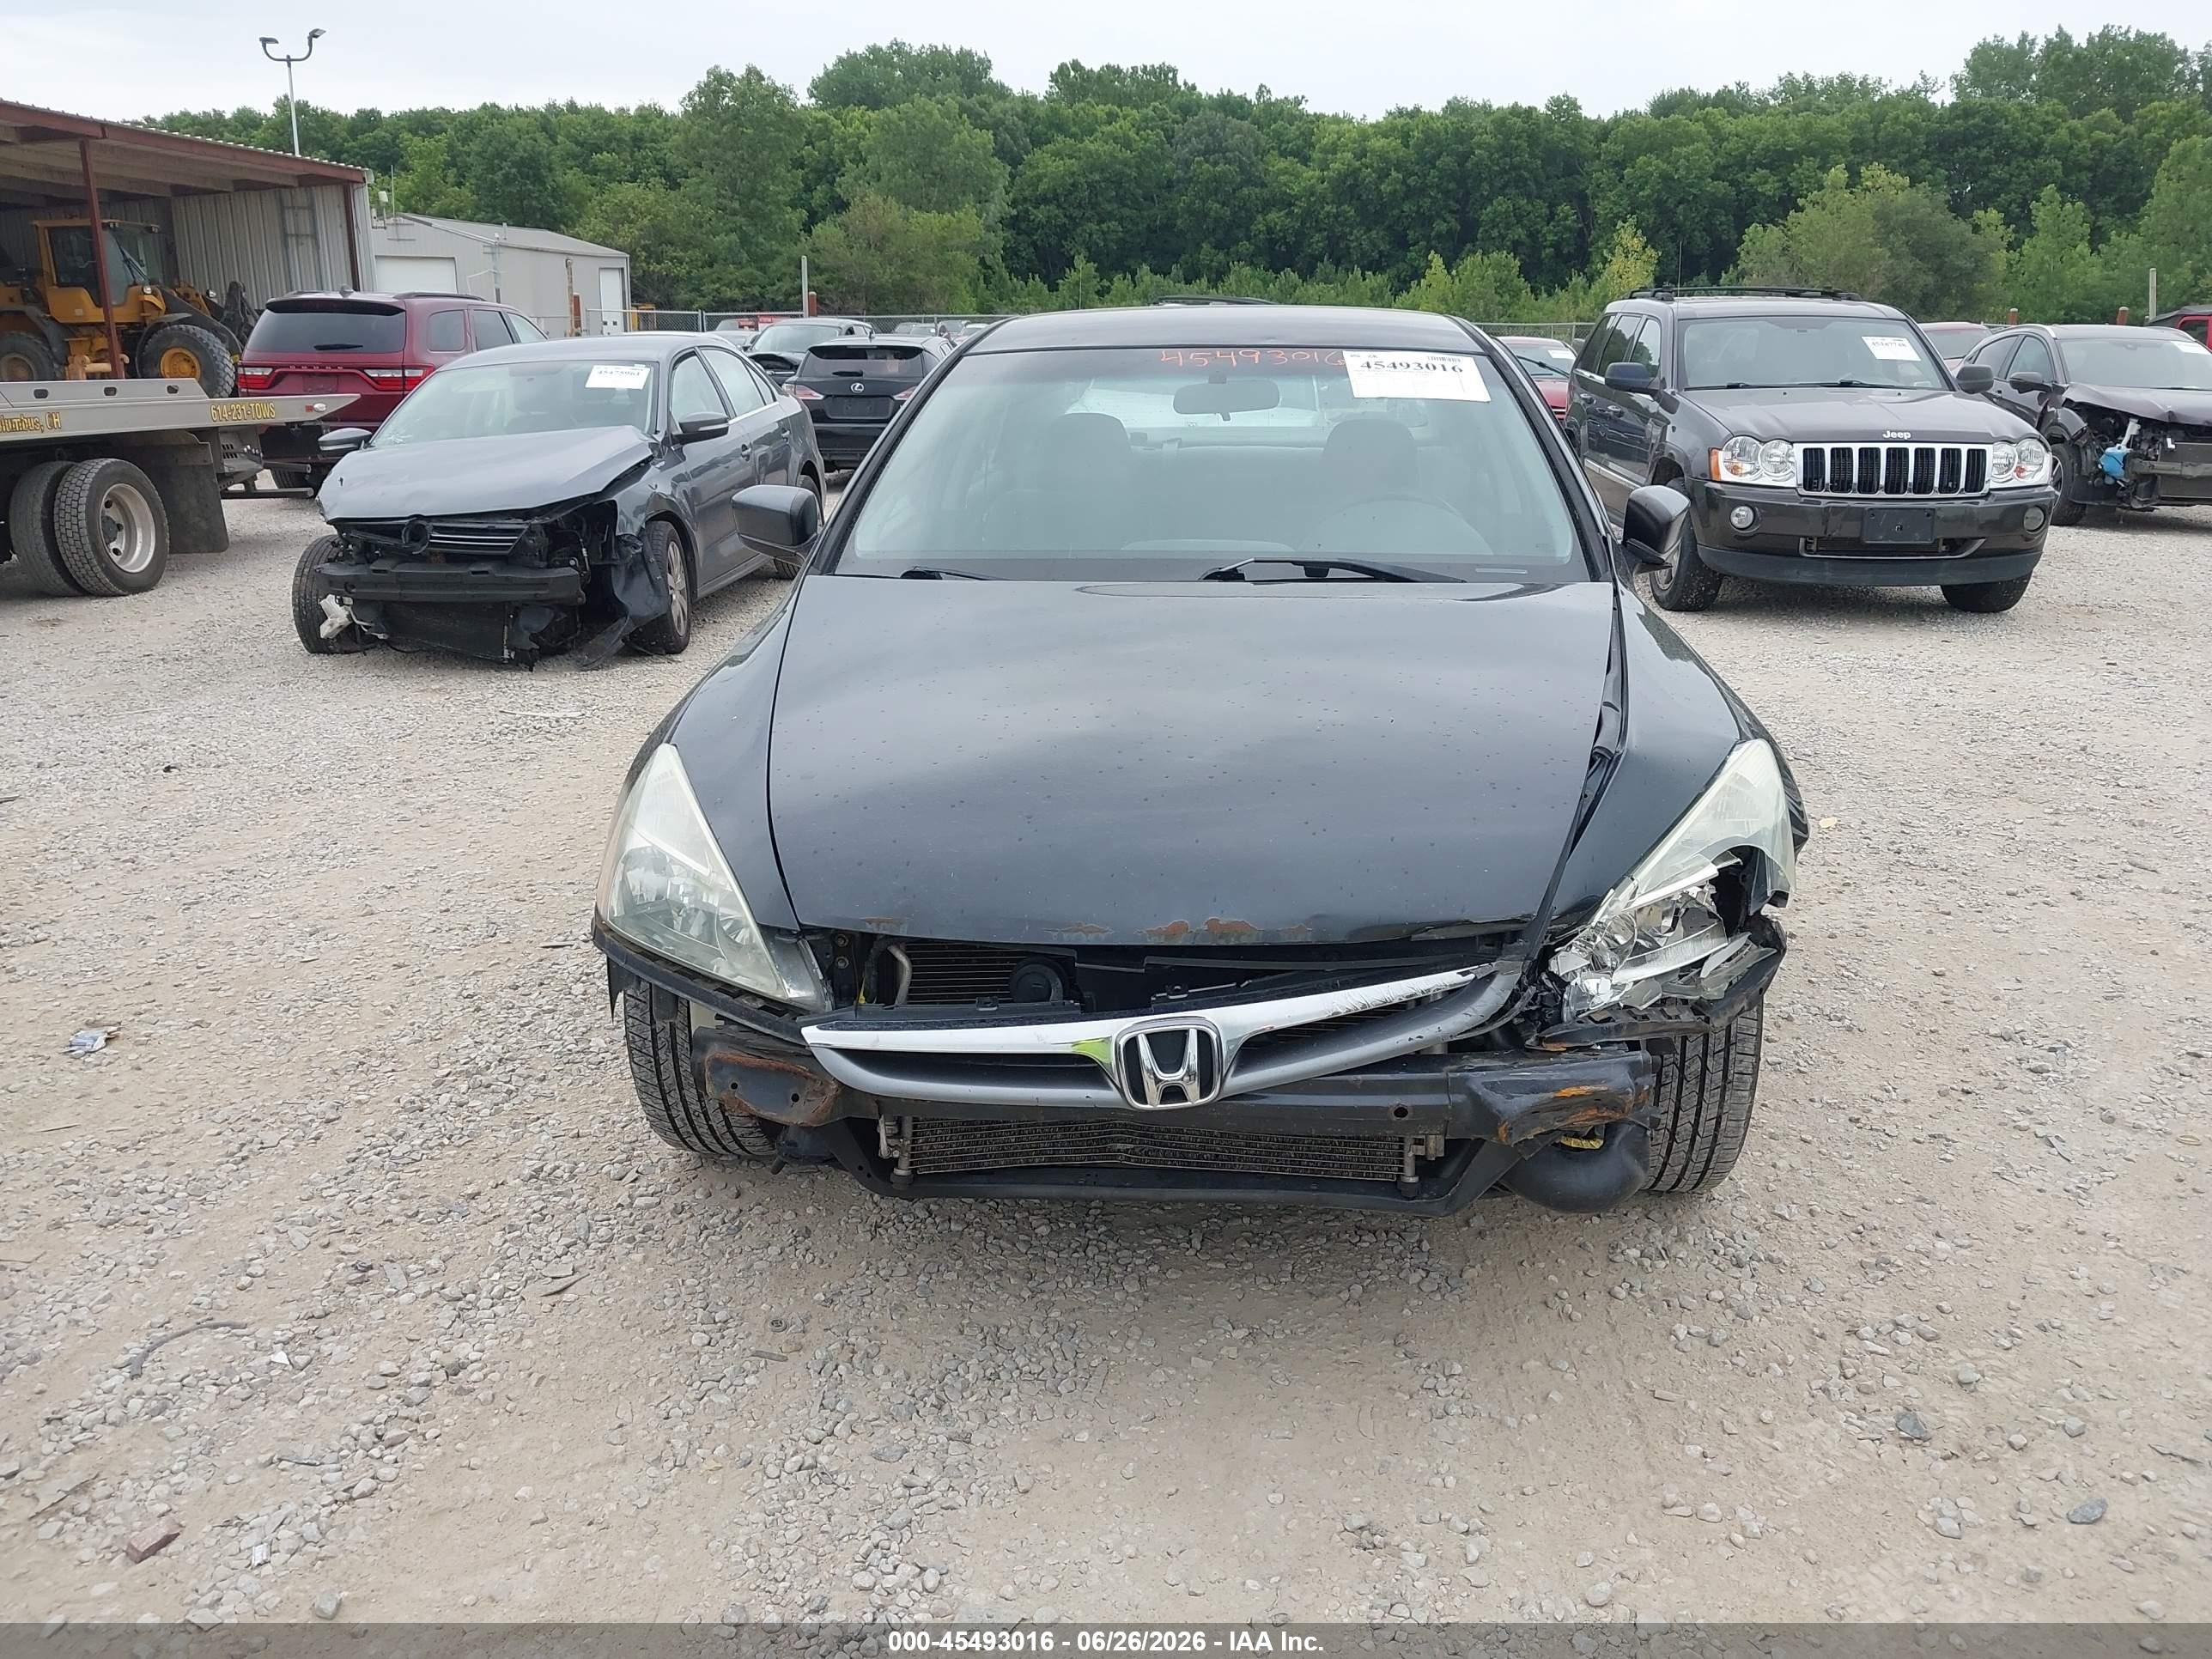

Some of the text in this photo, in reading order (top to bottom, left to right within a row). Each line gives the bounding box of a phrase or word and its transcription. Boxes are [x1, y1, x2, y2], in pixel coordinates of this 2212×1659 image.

[1160, 349, 1345, 367] 45493016
[1359, 360, 1464, 374] 45493016
[210, 403, 276, 422] 614-231-TOWS
[1882, 430, 1911, 440] Jeep
